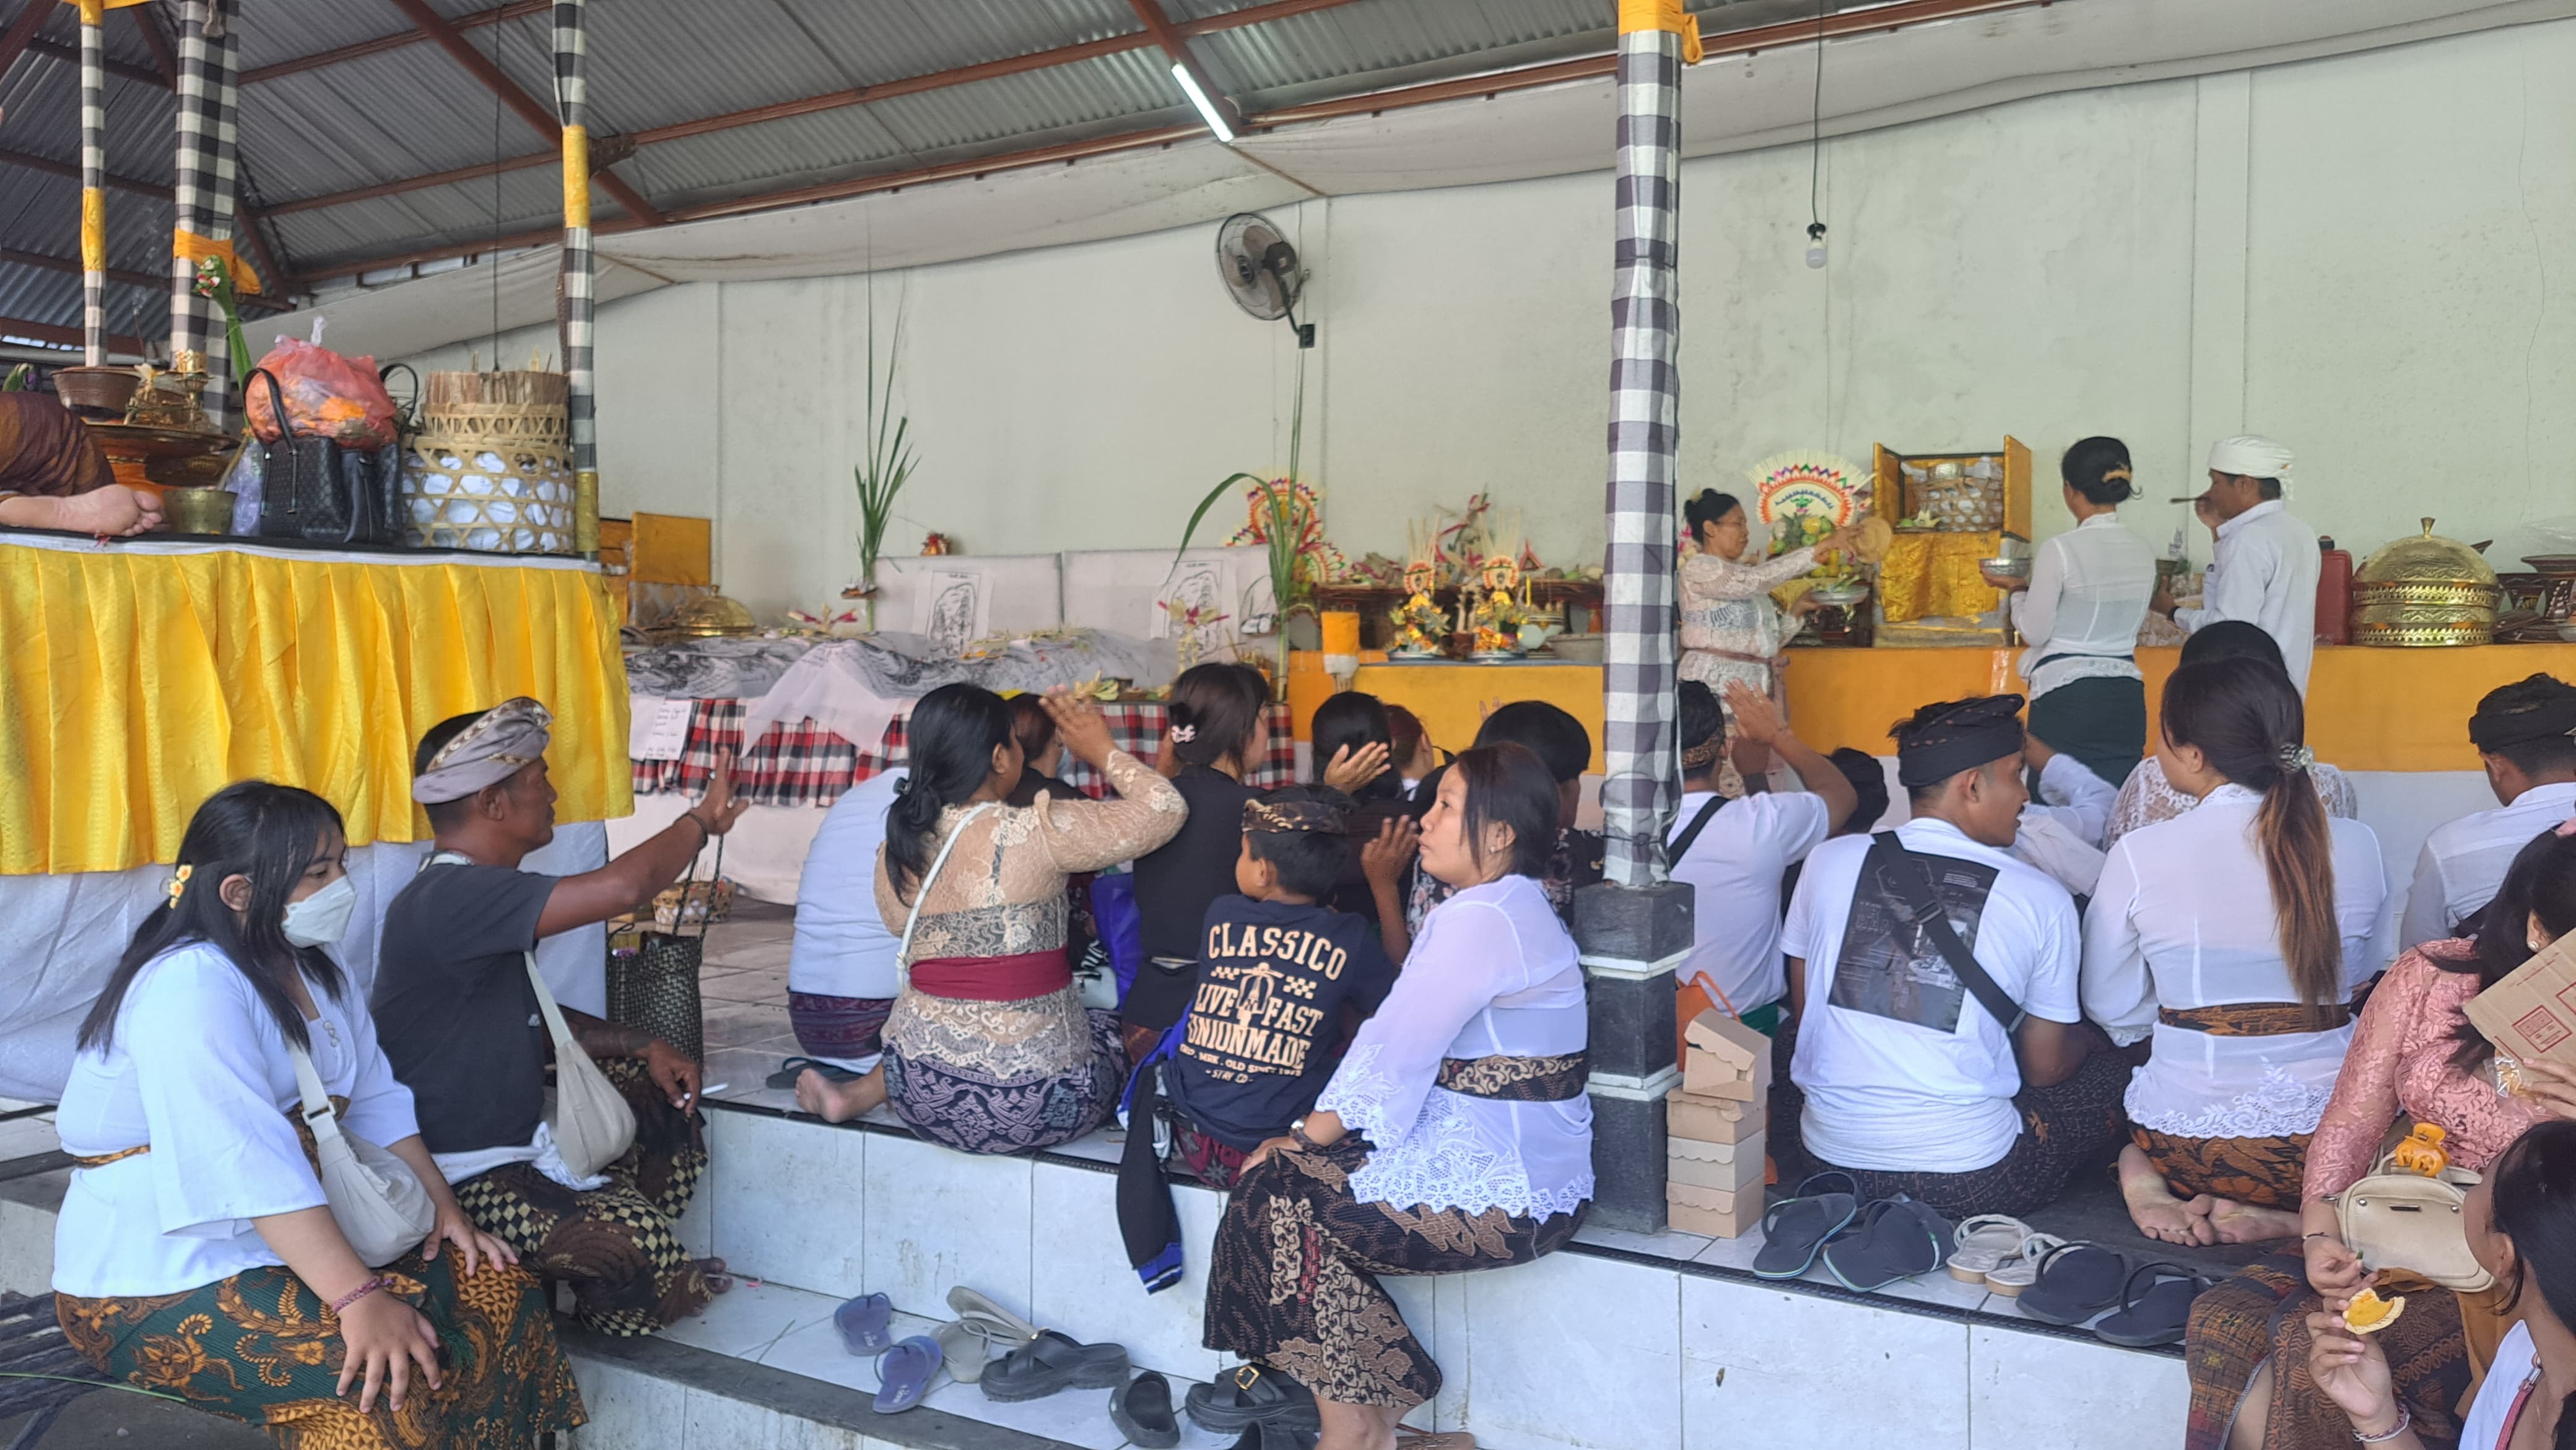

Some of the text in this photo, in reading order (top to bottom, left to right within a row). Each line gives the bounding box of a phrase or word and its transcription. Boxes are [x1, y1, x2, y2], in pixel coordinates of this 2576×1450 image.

[1209, 923, 1347, 980] CLASSICO
[1194, 983, 1323, 1036] LIVE FAST
[1187, 1014, 1311, 1070] UNIONMADE
[1225, 1059, 1246, 1072] OLD
